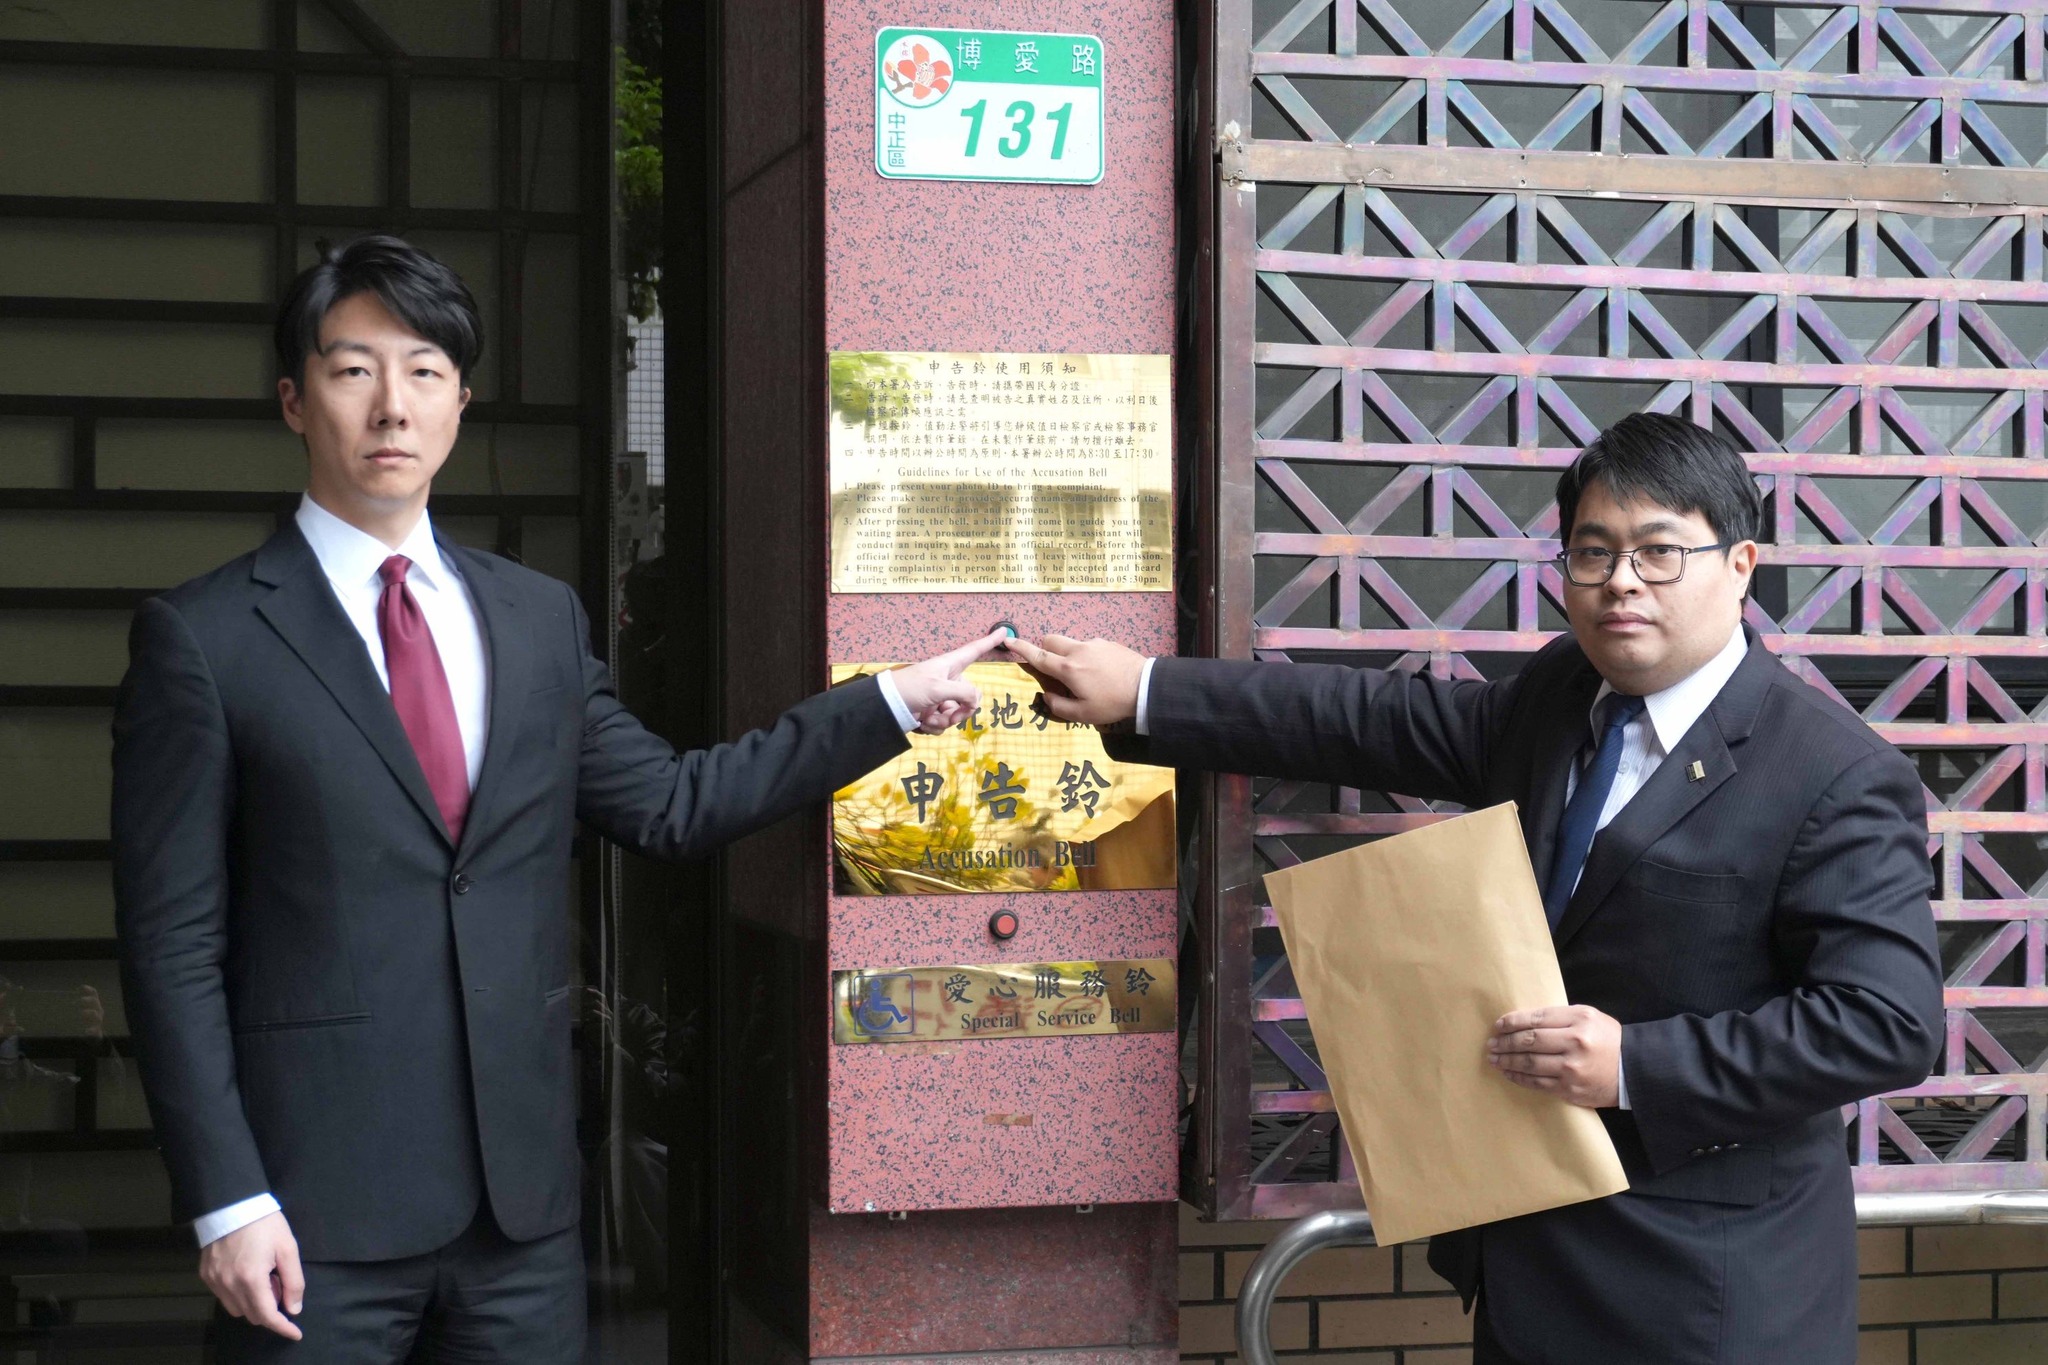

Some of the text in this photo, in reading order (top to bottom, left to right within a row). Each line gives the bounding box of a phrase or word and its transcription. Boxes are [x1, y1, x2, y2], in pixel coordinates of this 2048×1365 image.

[955, 37, 1096, 76] 博愛路
[960, 99, 1073, 160] 131
[887, 111, 906, 168] 中正區
[928, 360, 1077, 375] 申告鈴使用須知
[898, 467, 1107, 477] Guidelines for Use of the Accusation Bell
[891, 483, 925, 492] present
[931, 484, 951, 492] your
[956, 483, 983, 492] photo
[1018, 483, 1042, 492] bring
[1057, 484, 1106, 492] complaint.
[857, 494, 885, 502] Please
[891, 494, 915, 502] make
[959, 494, 994, 503] provide
[999, 495, 1038, 503] accurate
[1070, 495, 1087, 503] and
[1092, 495, 1126, 503] address
[1131, 495, 1140, 503] of
[1145, 495, 1159, 503] the
[856, 506, 892, 514] accused
[897, 506, 911, 514] for
[916, 506, 979, 514] identification
[984, 506, 1000, 514] and
[886, 518, 925, 526] pressing
[983, 518, 1013, 526] bailiff
[1017, 518, 1034, 526] will
[1080, 519, 1105, 527] guide
[857, 530, 891, 538] waiting
[936, 530, 986, 538] prosecutor
[857, 541, 893, 549] conduct
[915, 541, 948, 550] inquiry
[954, 541, 971, 549] and
[976, 541, 1001, 549] make
[857, 553, 889, 561] official
[895, 553, 925, 561] record
[931, 553, 938, 561] is
[975, 554, 991, 562] you
[1111, 553, 1163, 562] permission.
[857, 564, 884, 573] Filing
[1001, 564, 1023, 572] shall
[1028, 564, 1048, 573] only
[1053, 564, 1063, 572] be
[1068, 564, 1108, 573] accepted
[1113, 564, 1129, 572] and
[1134, 564, 1160, 572] heard
[856, 576, 887, 585] during
[973, 575, 1000, 583] office
[900, 759, 1111, 824] 申告鈴
[920, 840, 1097, 872] Accusation Bell
[943, 967, 1157, 1004] 愛心服務鈴
[961, 1006, 1141, 1031] Special Service Bell
